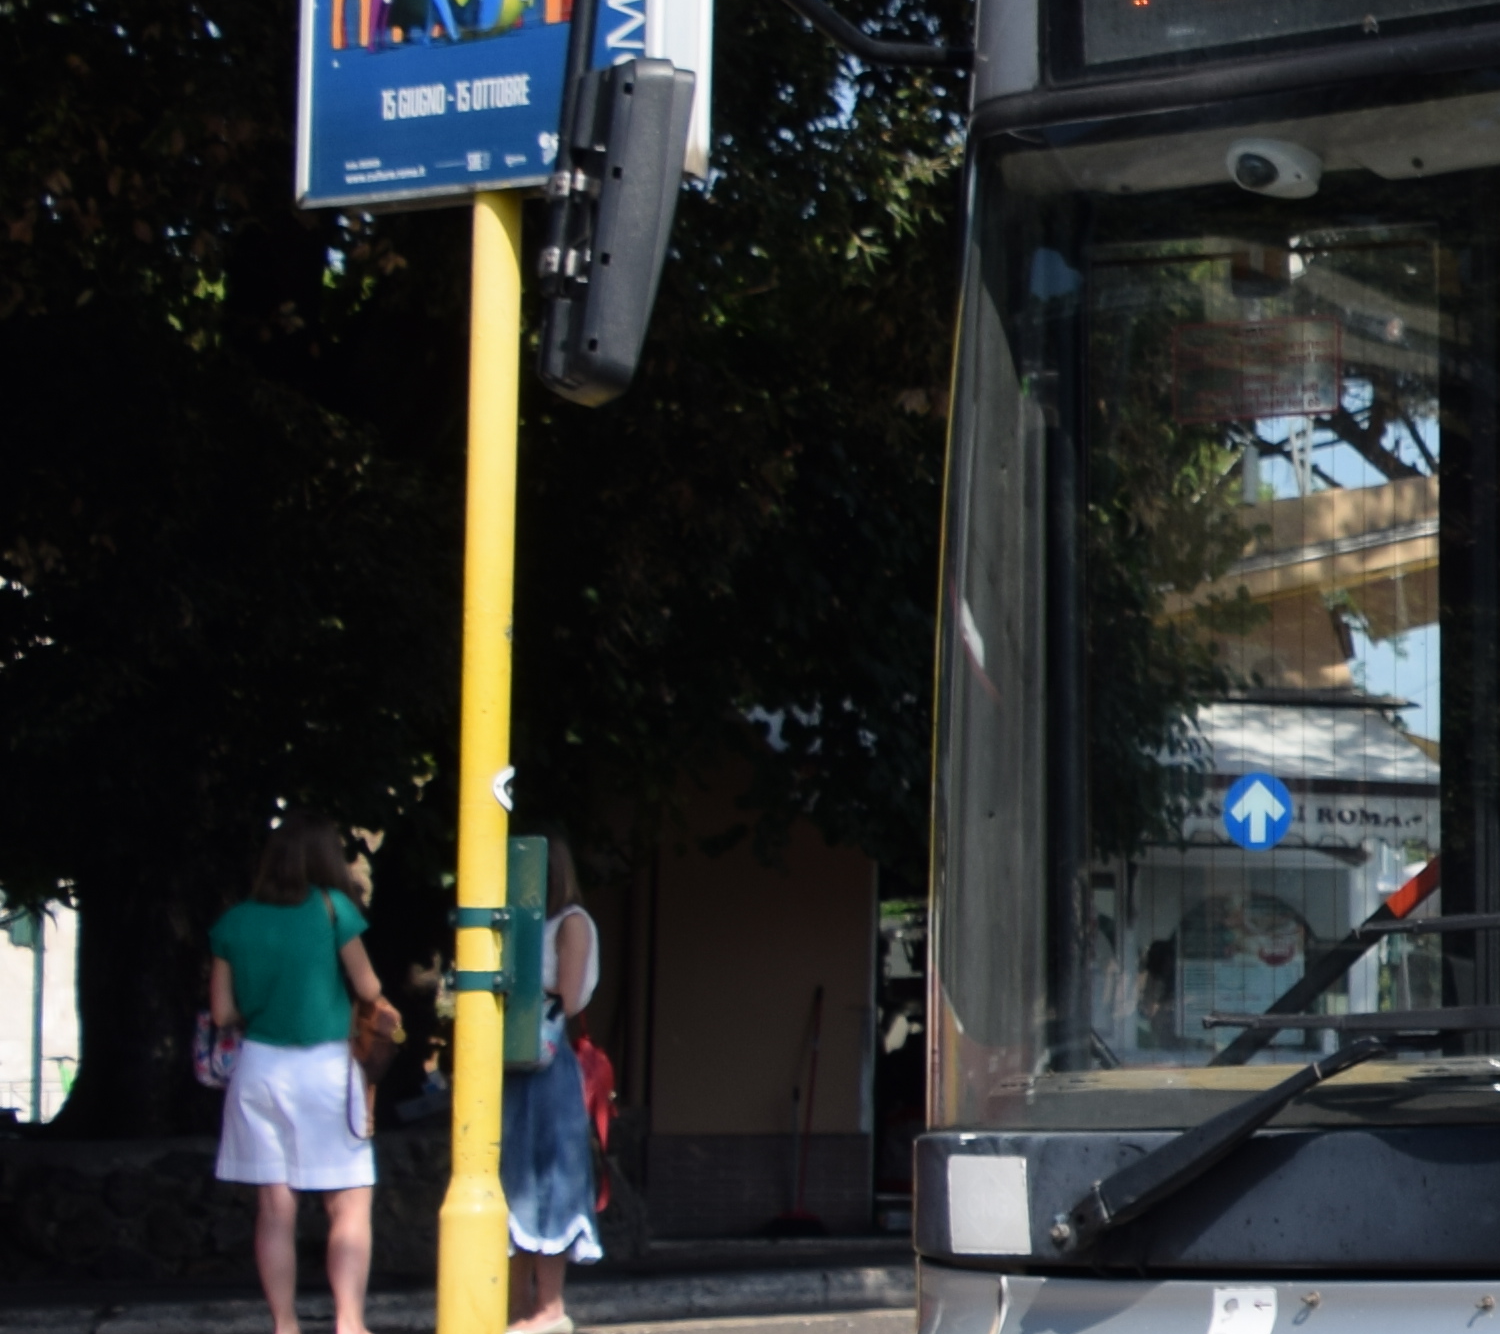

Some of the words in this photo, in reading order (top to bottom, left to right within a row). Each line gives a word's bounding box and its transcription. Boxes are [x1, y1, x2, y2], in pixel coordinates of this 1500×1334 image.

[381, 88, 397, 121] 15
[398, 83, 446, 119] GIUGNO
[456, 80, 471, 113] 15
[472, 73, 531, 111] OTTOBRE
